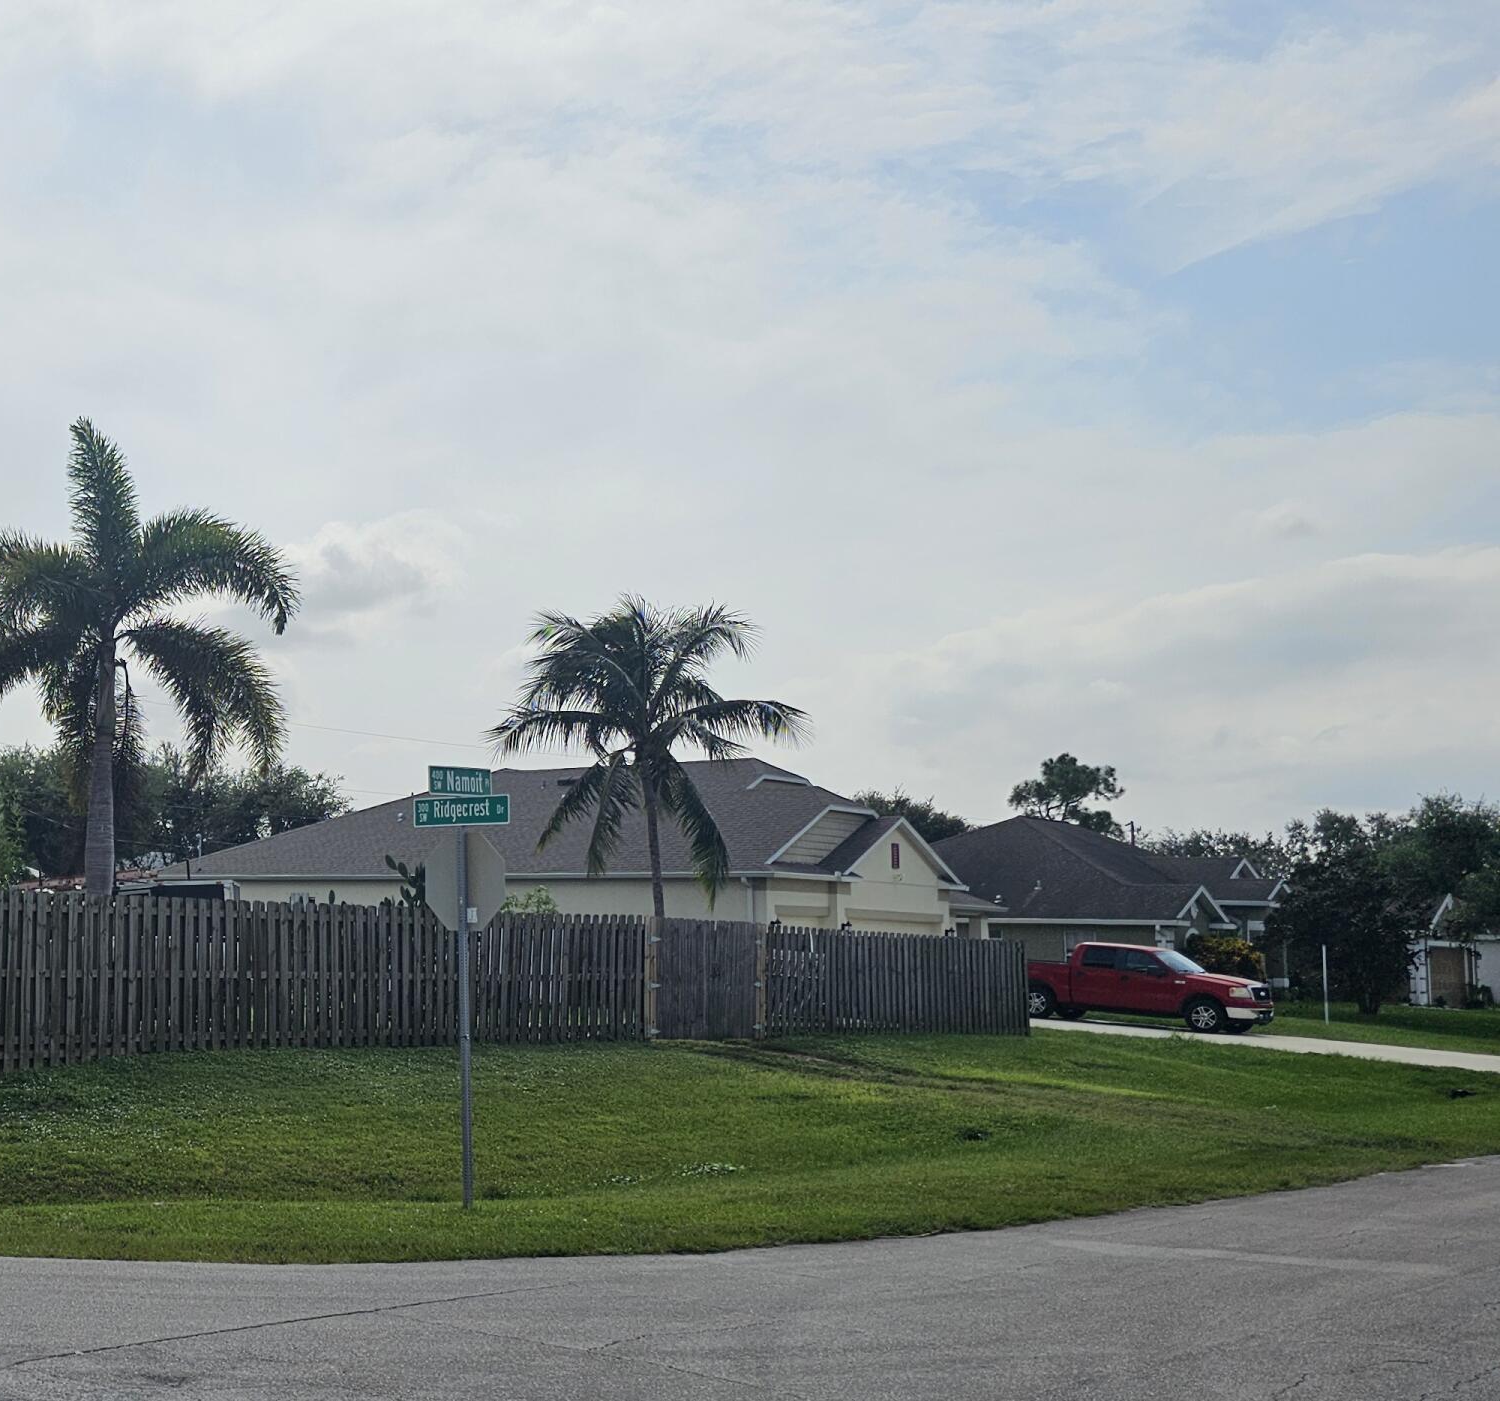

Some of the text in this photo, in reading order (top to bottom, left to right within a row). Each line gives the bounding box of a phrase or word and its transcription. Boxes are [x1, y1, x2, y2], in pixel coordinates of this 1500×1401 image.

[431, 770, 443, 780] 400
[433, 780, 442, 790] SW
[446, 770, 483, 793] Namoit
[433, 798, 504, 823] Ridgecrest Dr
[419, 813, 428, 823] SW
